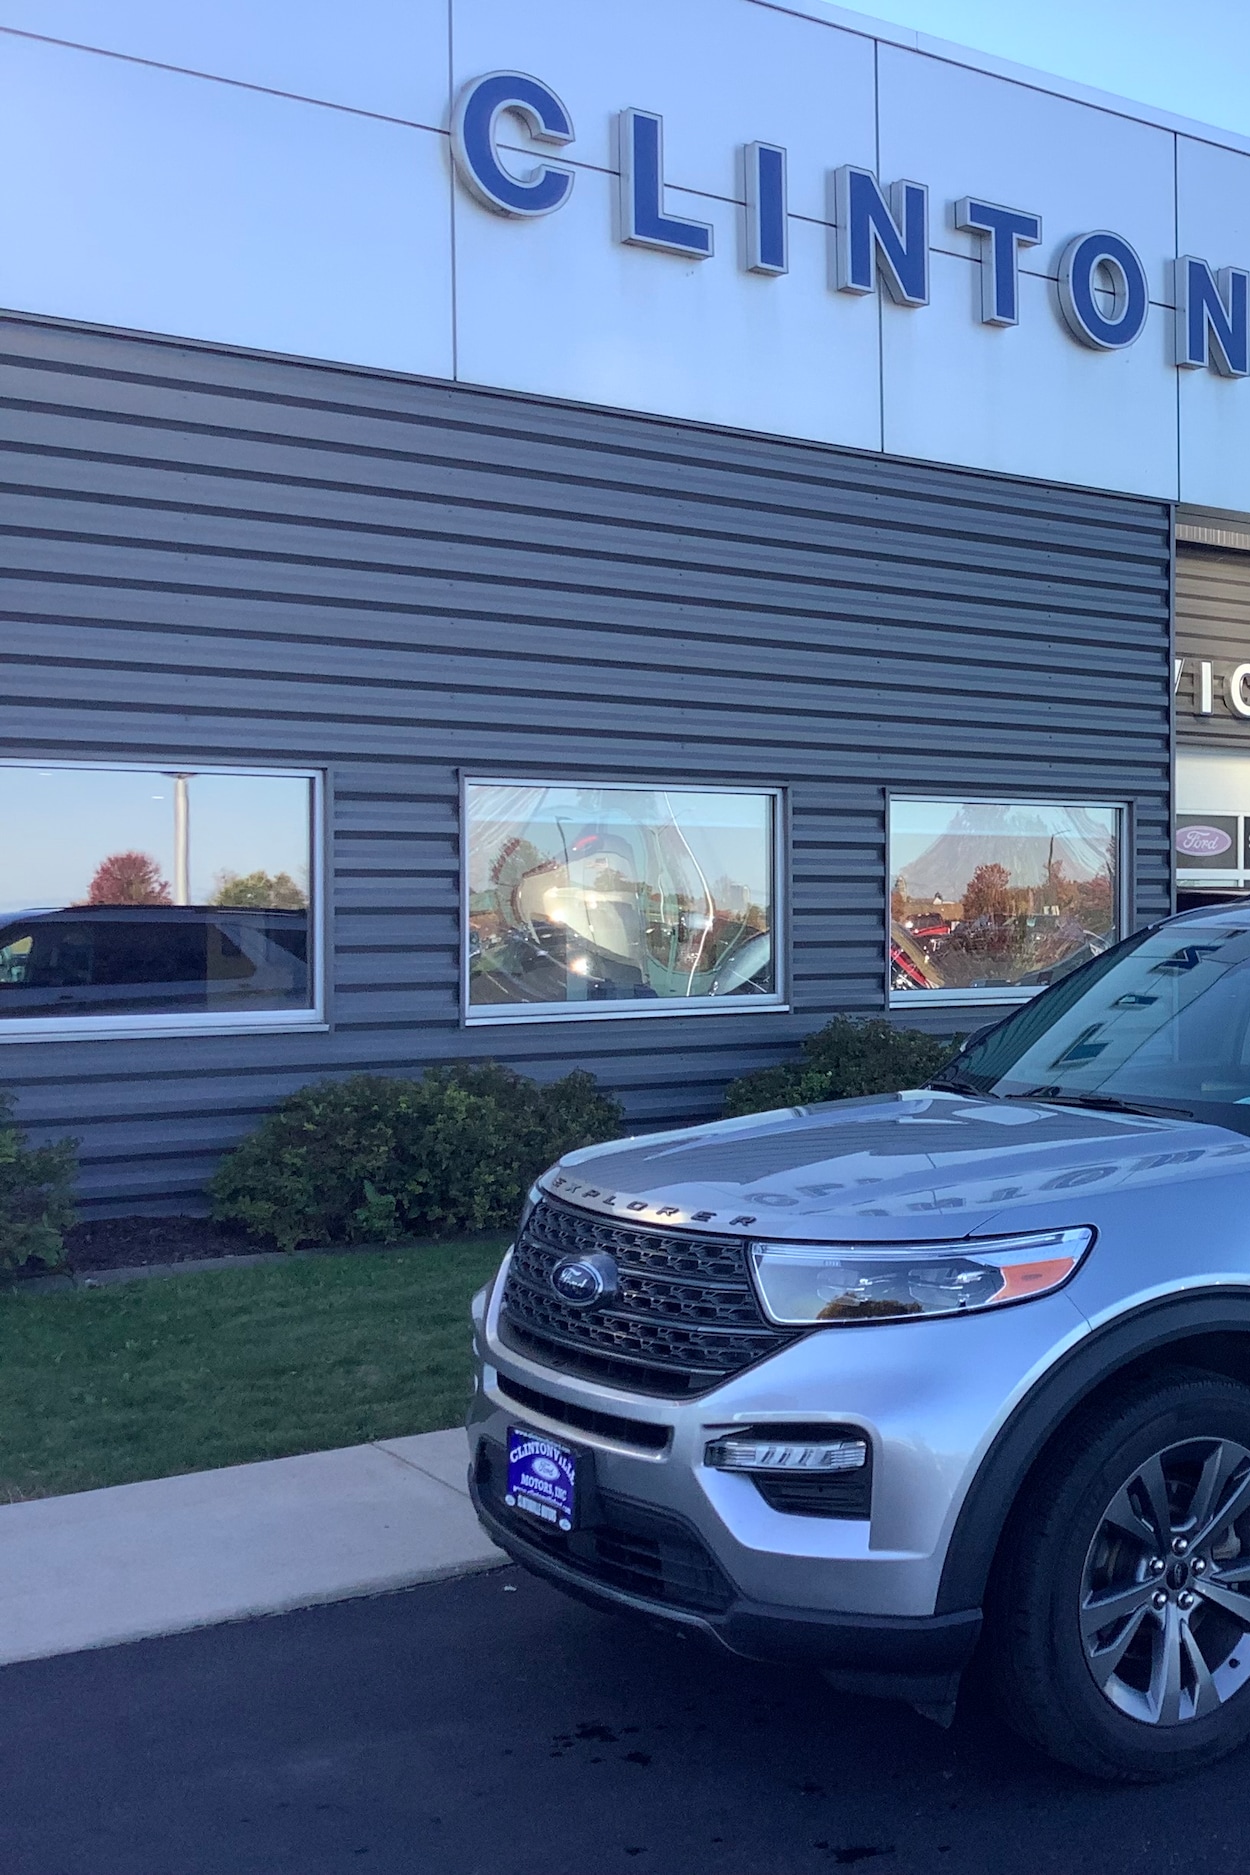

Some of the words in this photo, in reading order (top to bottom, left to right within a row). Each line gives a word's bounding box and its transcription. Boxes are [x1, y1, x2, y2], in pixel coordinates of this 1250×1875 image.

[1182, 831, 1219, 850] Ford
[552, 1176, 758, 1228] EXPLORER
[559, 1266, 588, 1290] Ford
